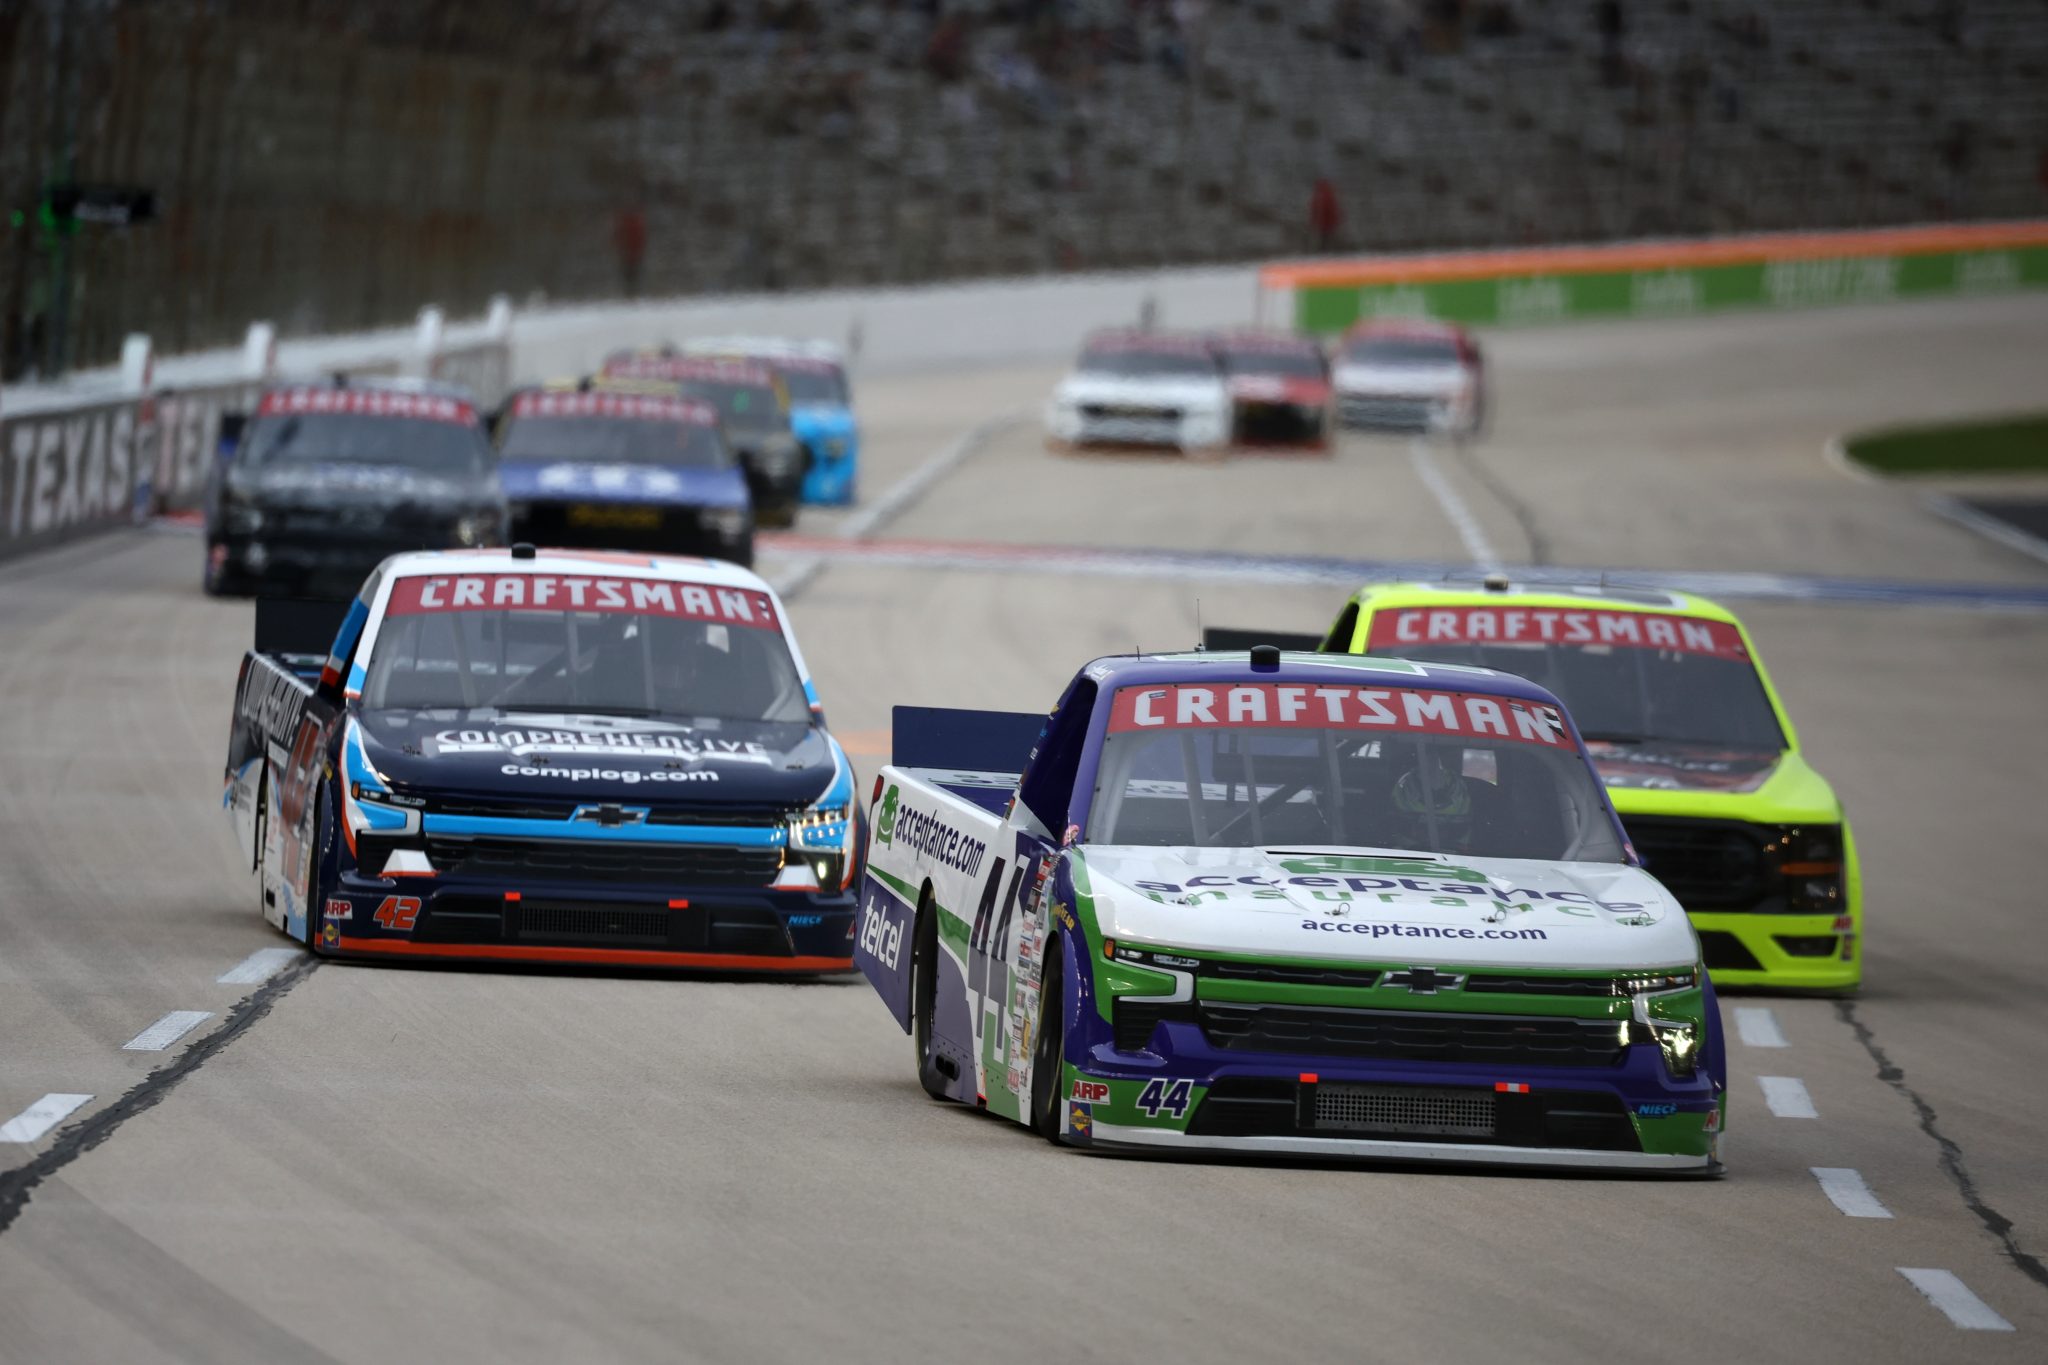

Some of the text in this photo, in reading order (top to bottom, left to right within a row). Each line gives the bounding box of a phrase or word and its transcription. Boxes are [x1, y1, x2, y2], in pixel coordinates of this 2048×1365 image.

[10, 404, 135, 540] TEXAS
[419, 578, 754, 622] CRAFTSMAN
[1396, 612, 1716, 651] CRAFTSMAN
[1134, 686, 1558, 744] CRAFTSMAN
[501, 763, 719, 783] complog.com
[895, 803, 986, 878] acceptance.com
[324, 899, 352, 917] ARP
[373, 895, 422, 931] 42
[1134, 875, 1645, 914] acceptance
[860, 895, 905, 971] telcel
[1302, 919, 1547, 940] acceptance.com
[1072, 1081, 1109, 1102] ARP
[1136, 1078, 1194, 1119] 44
